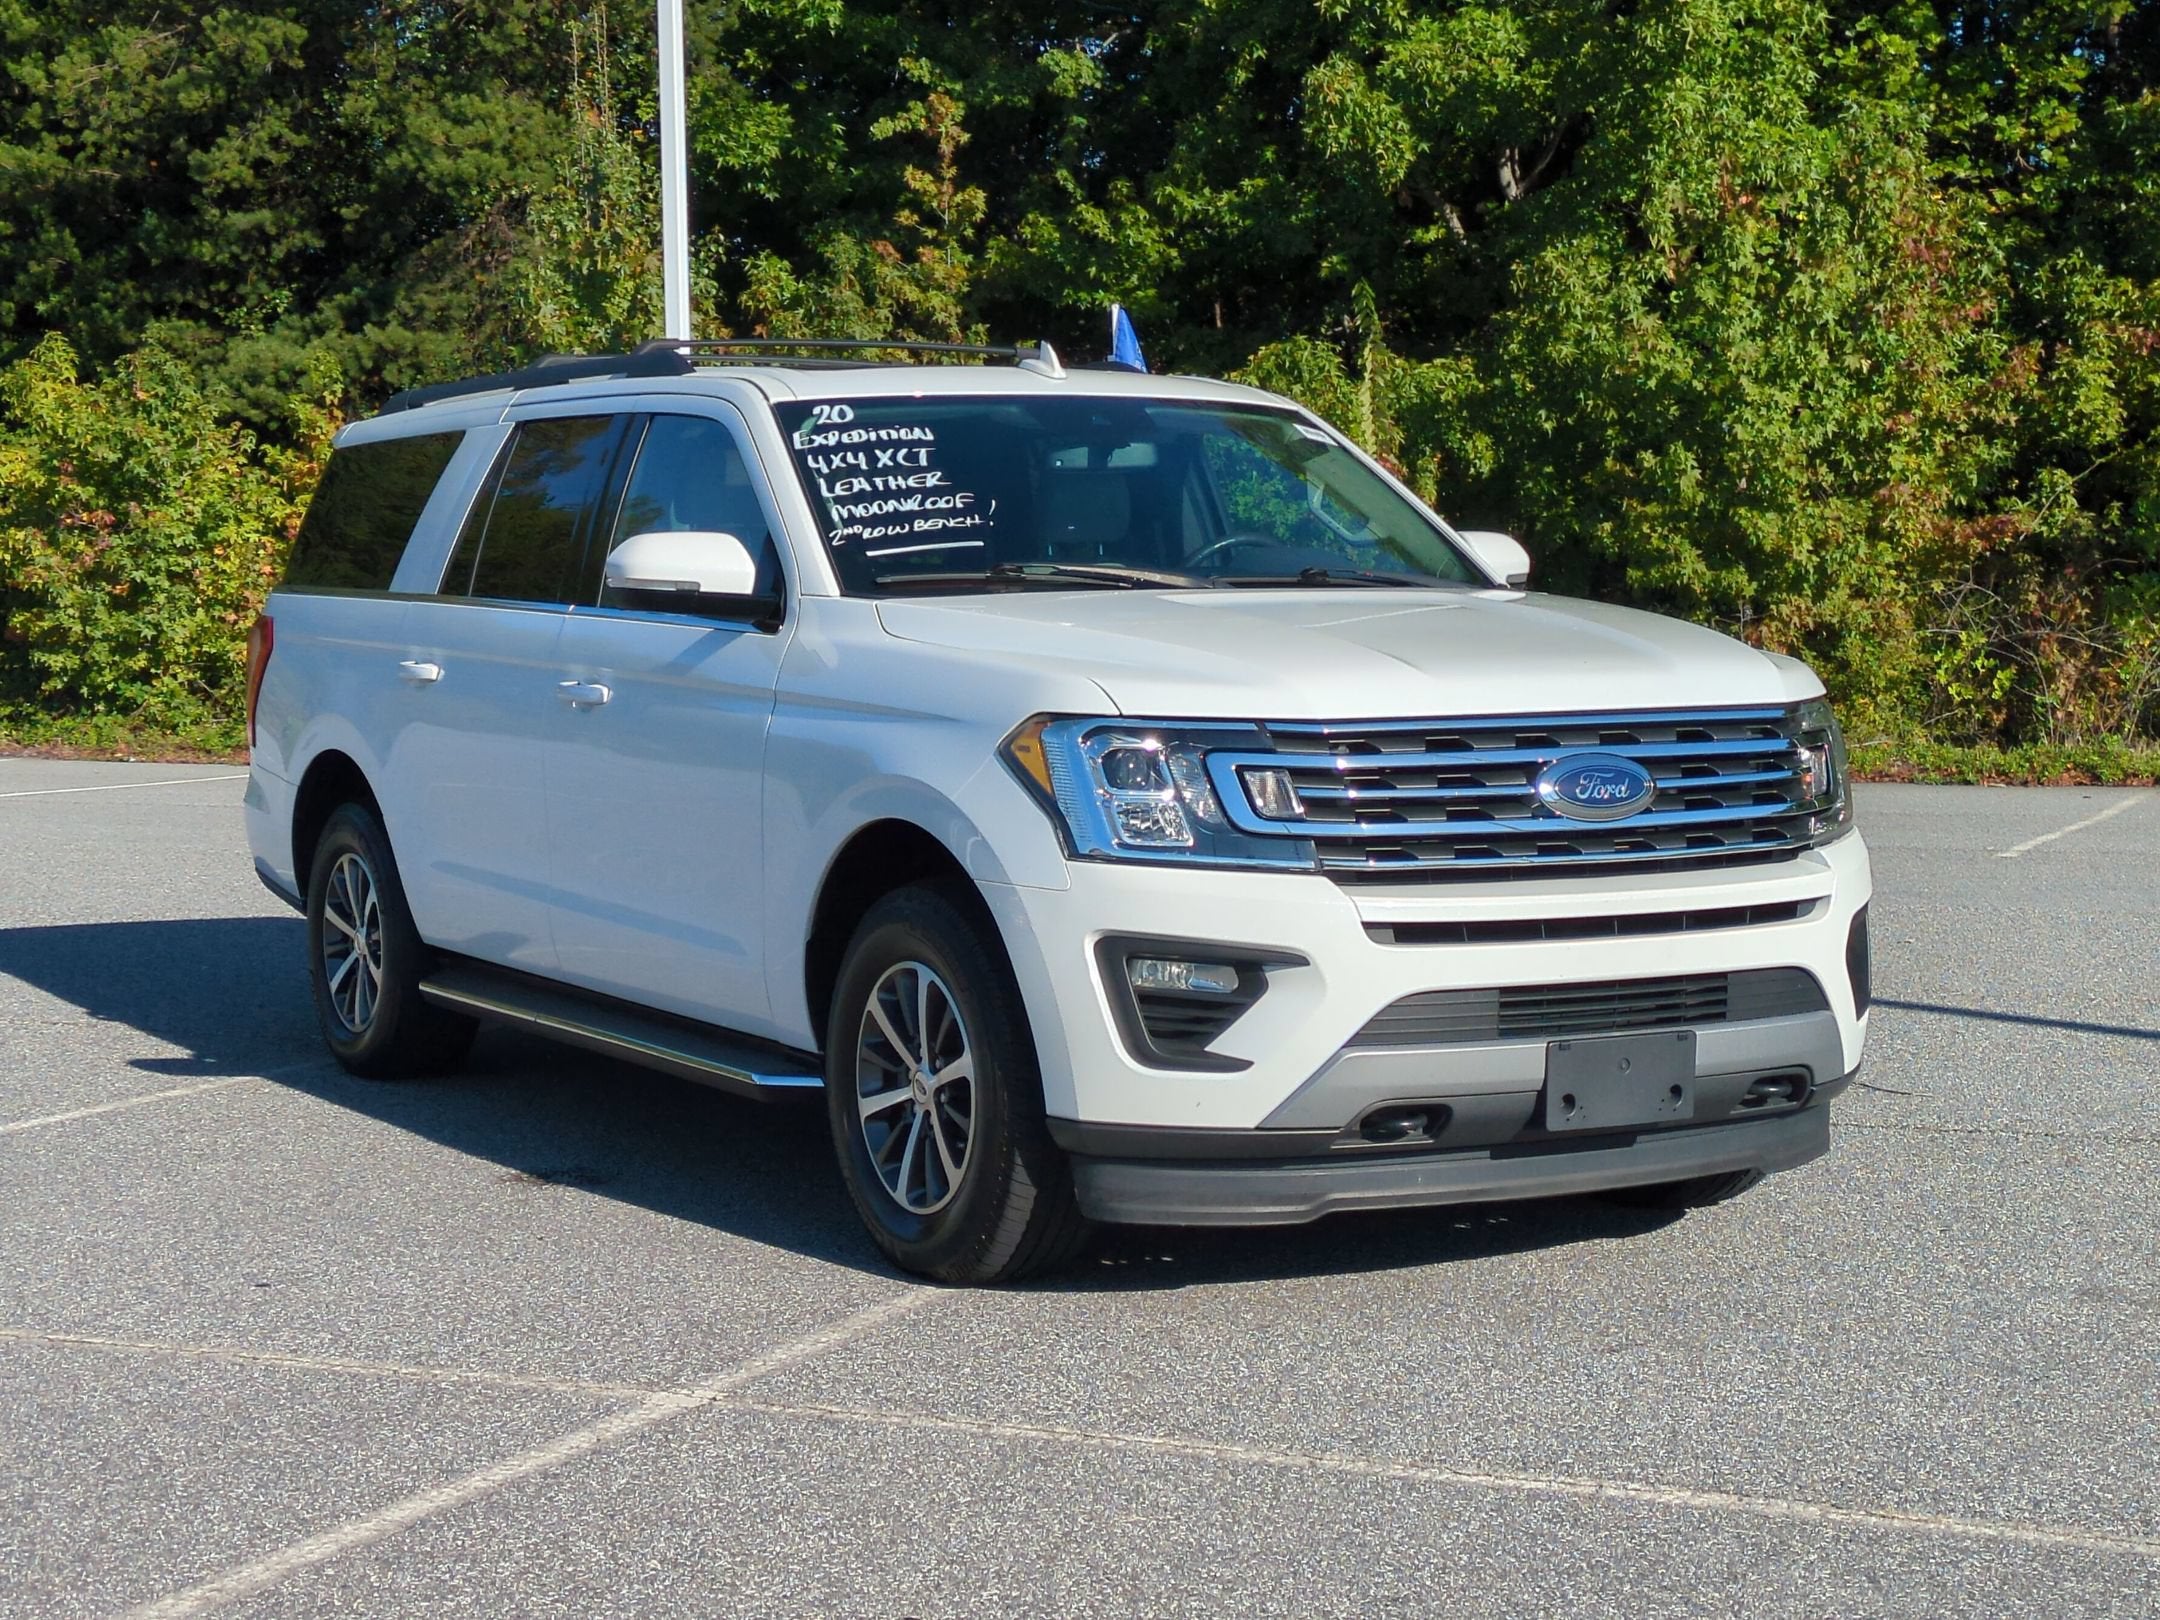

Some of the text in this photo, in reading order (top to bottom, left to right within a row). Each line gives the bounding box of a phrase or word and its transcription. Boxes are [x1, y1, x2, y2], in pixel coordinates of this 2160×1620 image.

[812, 404, 854, 424] 20
[807, 451, 869, 474] 4X4
[819, 472, 952, 497] LEATHER
[831, 493, 975, 522] MOONROOF
[862, 523, 910, 539] ROW
[1575, 772, 1631, 799] Ford
